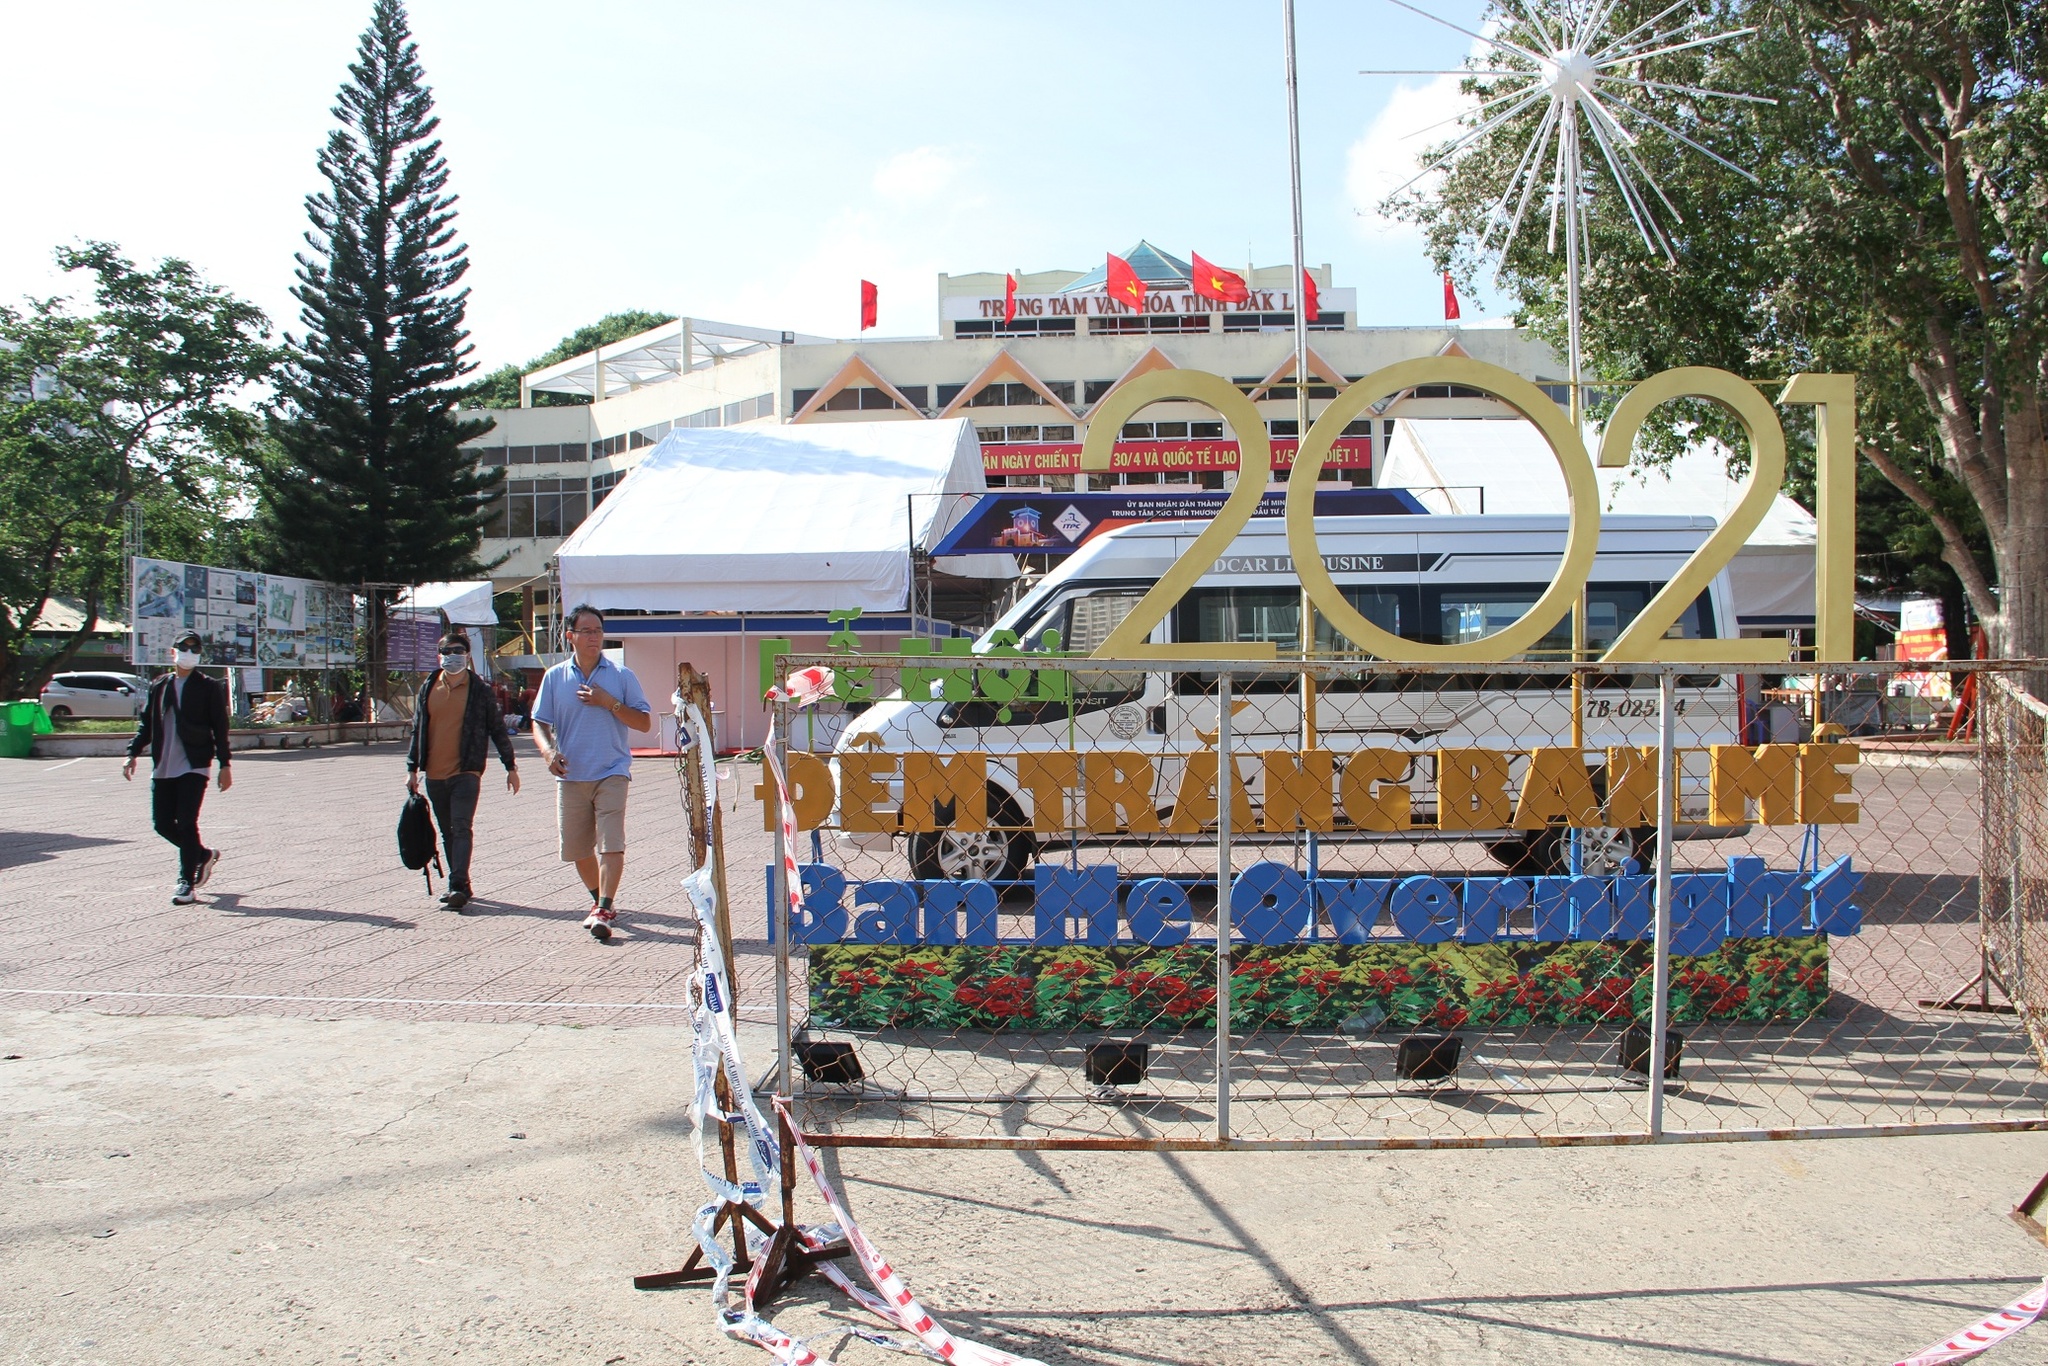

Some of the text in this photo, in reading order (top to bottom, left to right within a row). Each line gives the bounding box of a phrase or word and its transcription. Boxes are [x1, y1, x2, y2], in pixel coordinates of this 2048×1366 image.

[1002, 451, 1031, 469] NGÀY
[1035, 449, 1069, 469] CHIẾN
[1113, 452, 1140, 467] 30/4
[1144, 449, 1158, 466] VÀ
[1162, 446, 1193, 466] QUỐC
[1196, 445, 1212, 465] TẾ
[1215, 451, 1237, 465] LAO
[1275, 449, 1294, 464] 1/5
[1082, 356, 1857, 664] 2021
[1273, 556, 1384, 572] LIUSINE
[1709, 723, 1860, 827] MÊ
[766, 861, 998, 946] Ban
[1035, 863, 1193, 946] Me
[1230, 854, 1863, 957] Overnight
